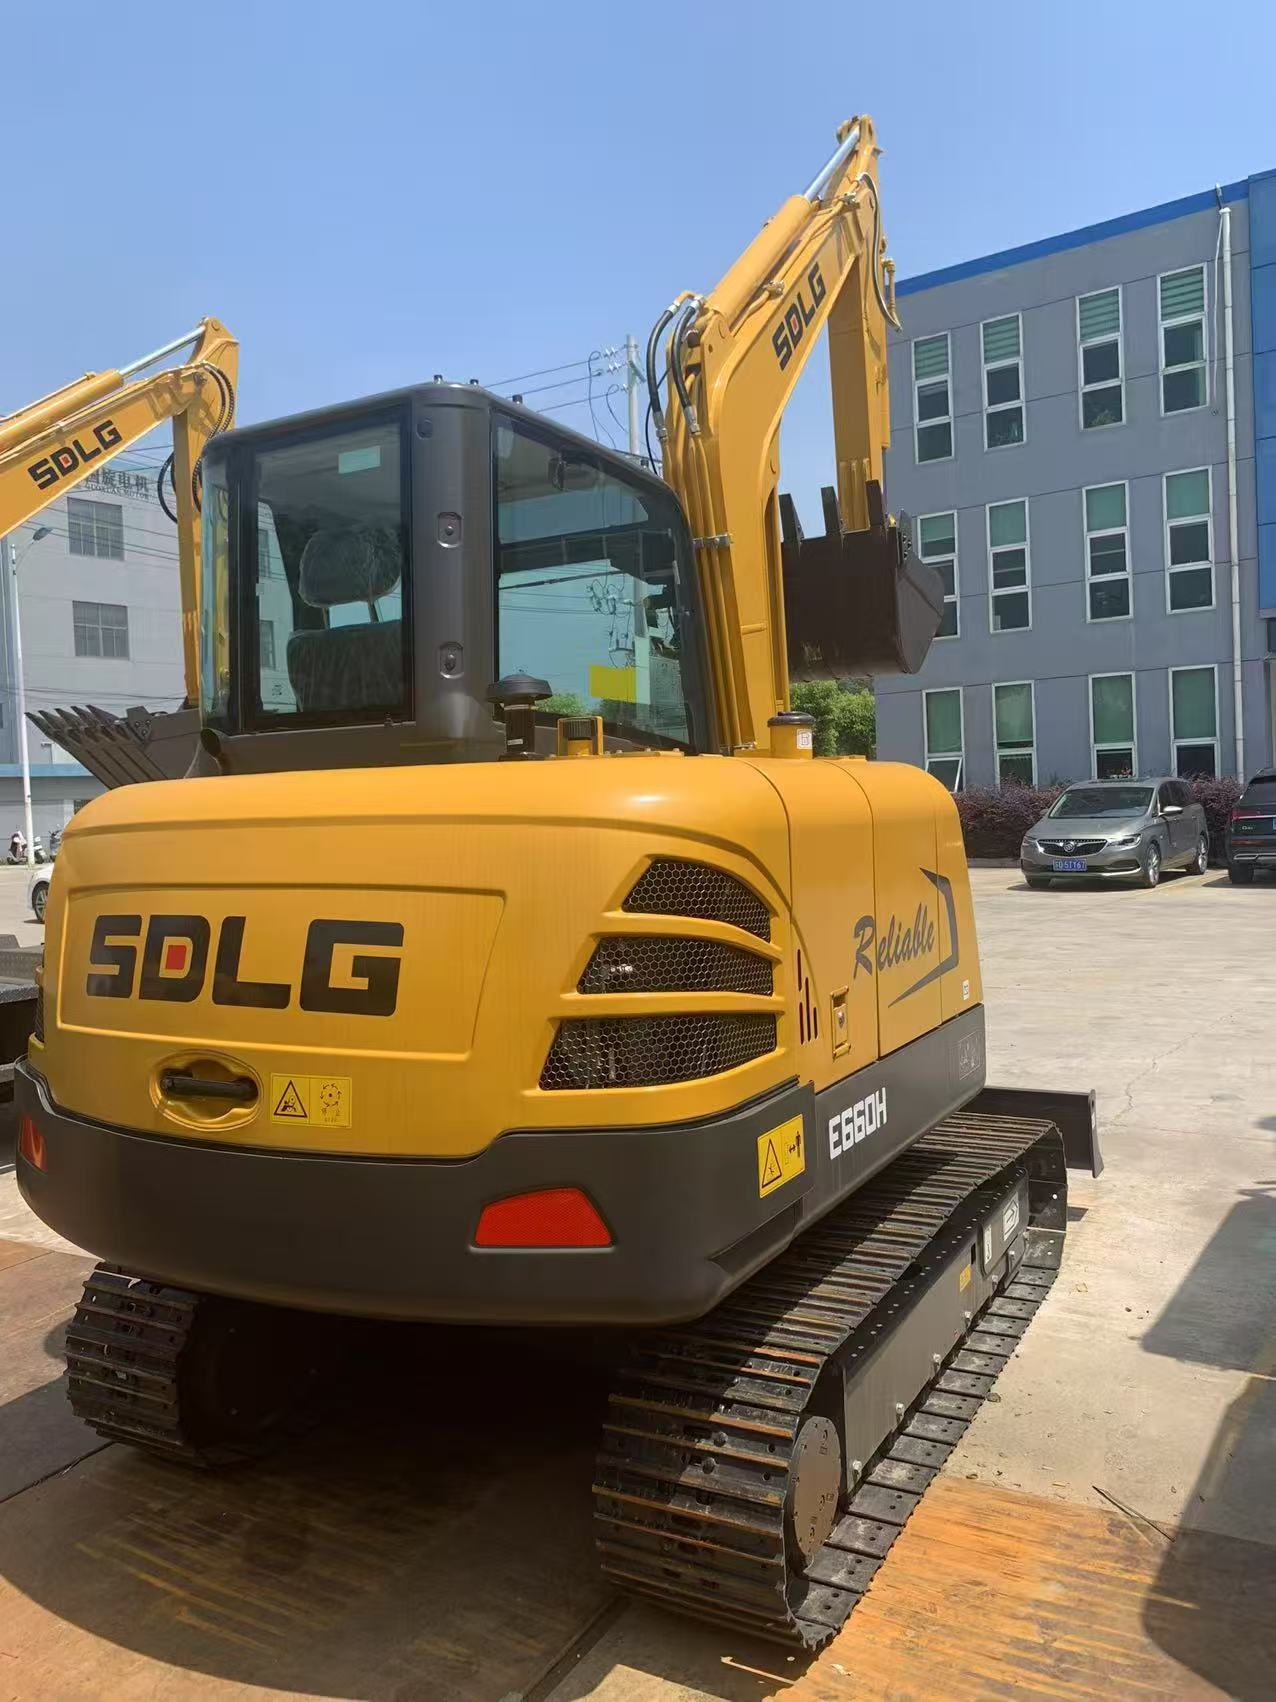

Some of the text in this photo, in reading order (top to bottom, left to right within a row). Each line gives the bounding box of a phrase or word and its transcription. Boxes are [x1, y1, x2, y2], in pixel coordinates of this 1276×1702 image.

[772, 261, 826, 371] SDLG
[28, 419, 122, 490] SDLG
[86, 914, 405, 1017] SDLG
[854, 902, 935, 979] Reliable
[829, 1087, 887, 1160] E660H
